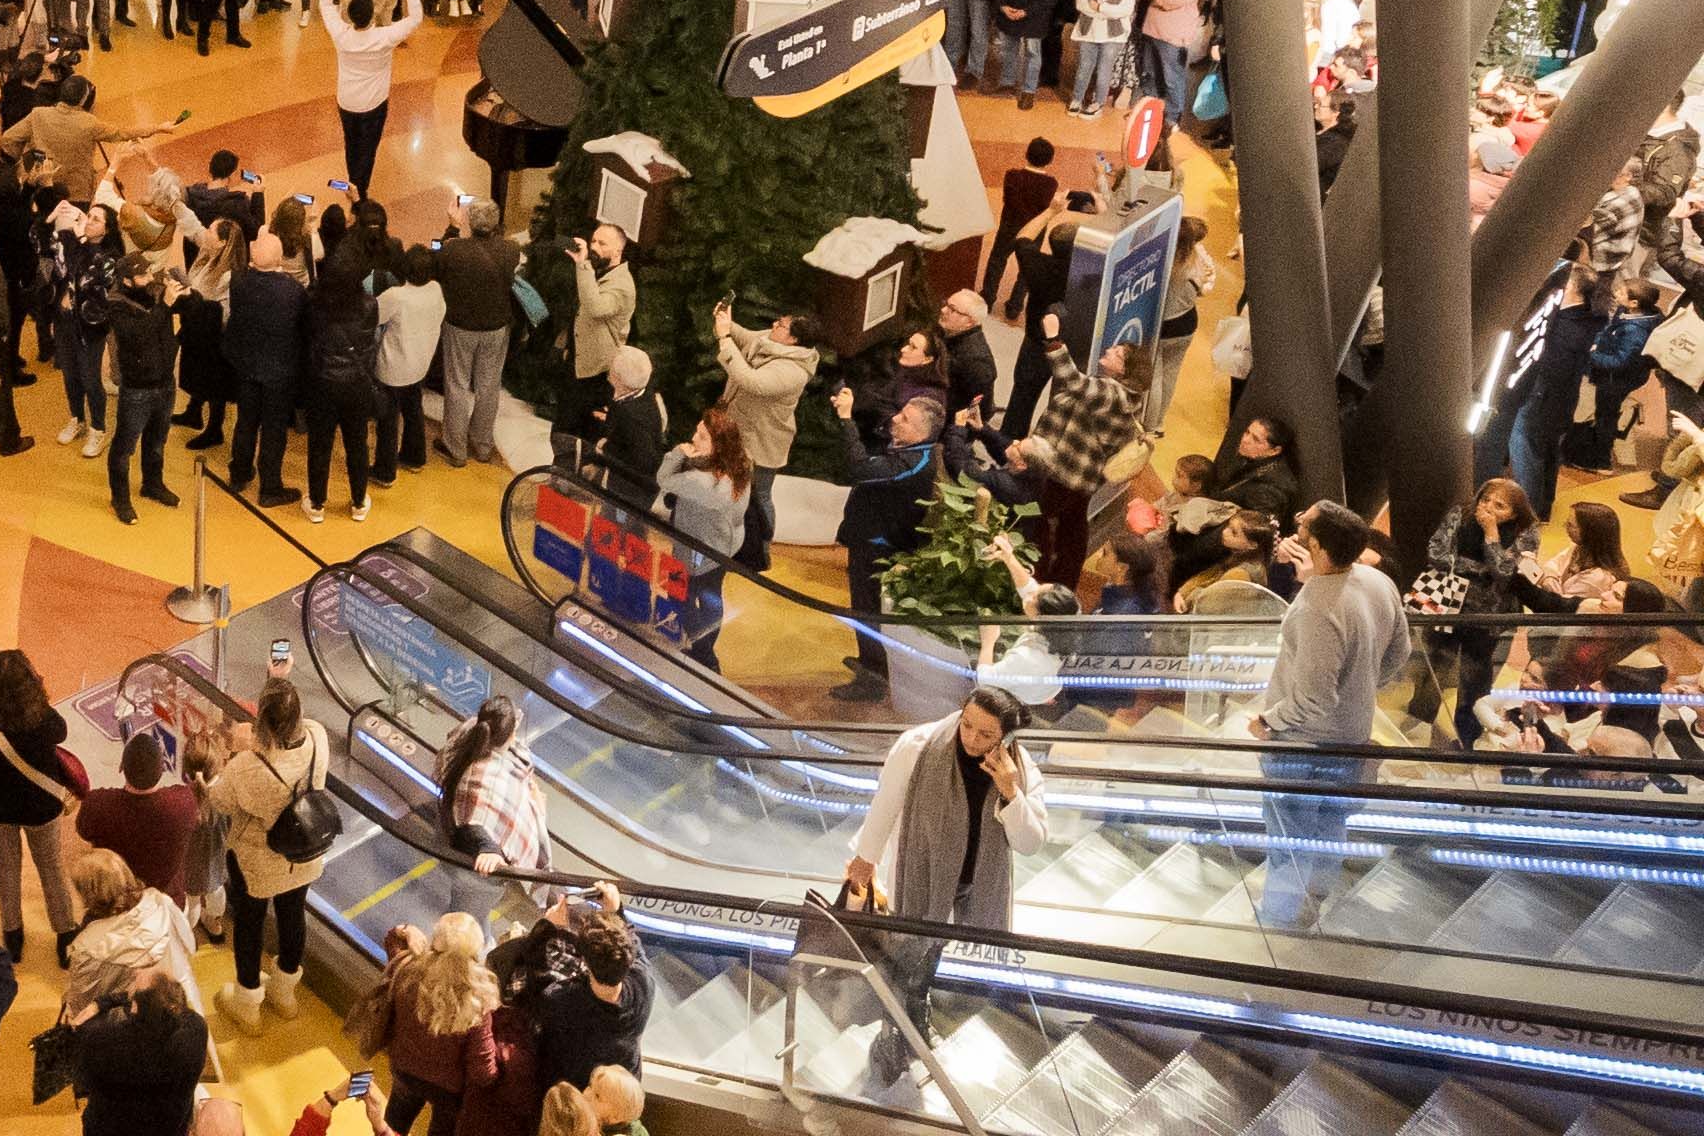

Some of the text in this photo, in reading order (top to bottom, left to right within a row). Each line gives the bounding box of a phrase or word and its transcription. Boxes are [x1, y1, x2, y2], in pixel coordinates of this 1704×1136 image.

[781, 51, 814, 70] Planta
[1113, 268, 1157, 313] TÁCTIL
[629, 896, 659, 909] NO
[661, 900, 723, 920] PONGA
[728, 908, 764, 926] LOS
[1367, 999, 1425, 1020] LOS
